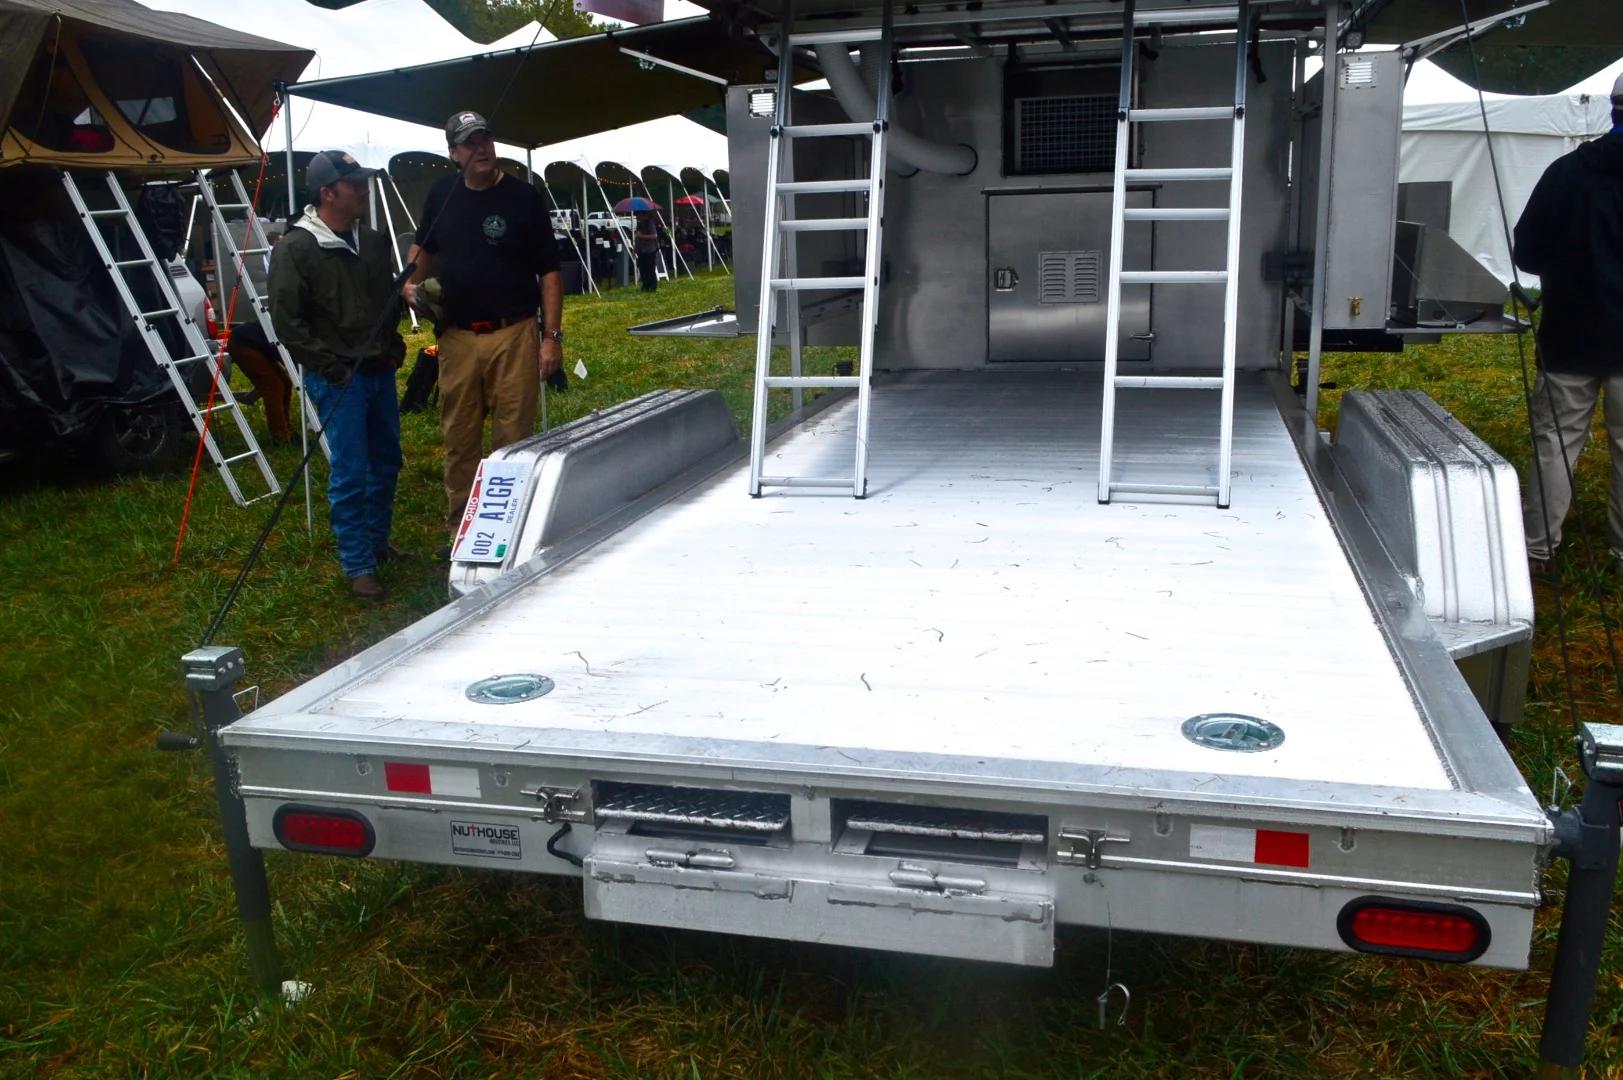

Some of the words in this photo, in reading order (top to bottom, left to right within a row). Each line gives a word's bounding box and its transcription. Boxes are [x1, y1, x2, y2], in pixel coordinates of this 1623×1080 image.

[465, 496, 479, 521] OHIO
[479, 476, 516, 521] A1GR
[506, 498, 519, 524] DEALER
[471, 531, 495, 556] 002
[453, 824, 518, 840] NUTHOUSE
